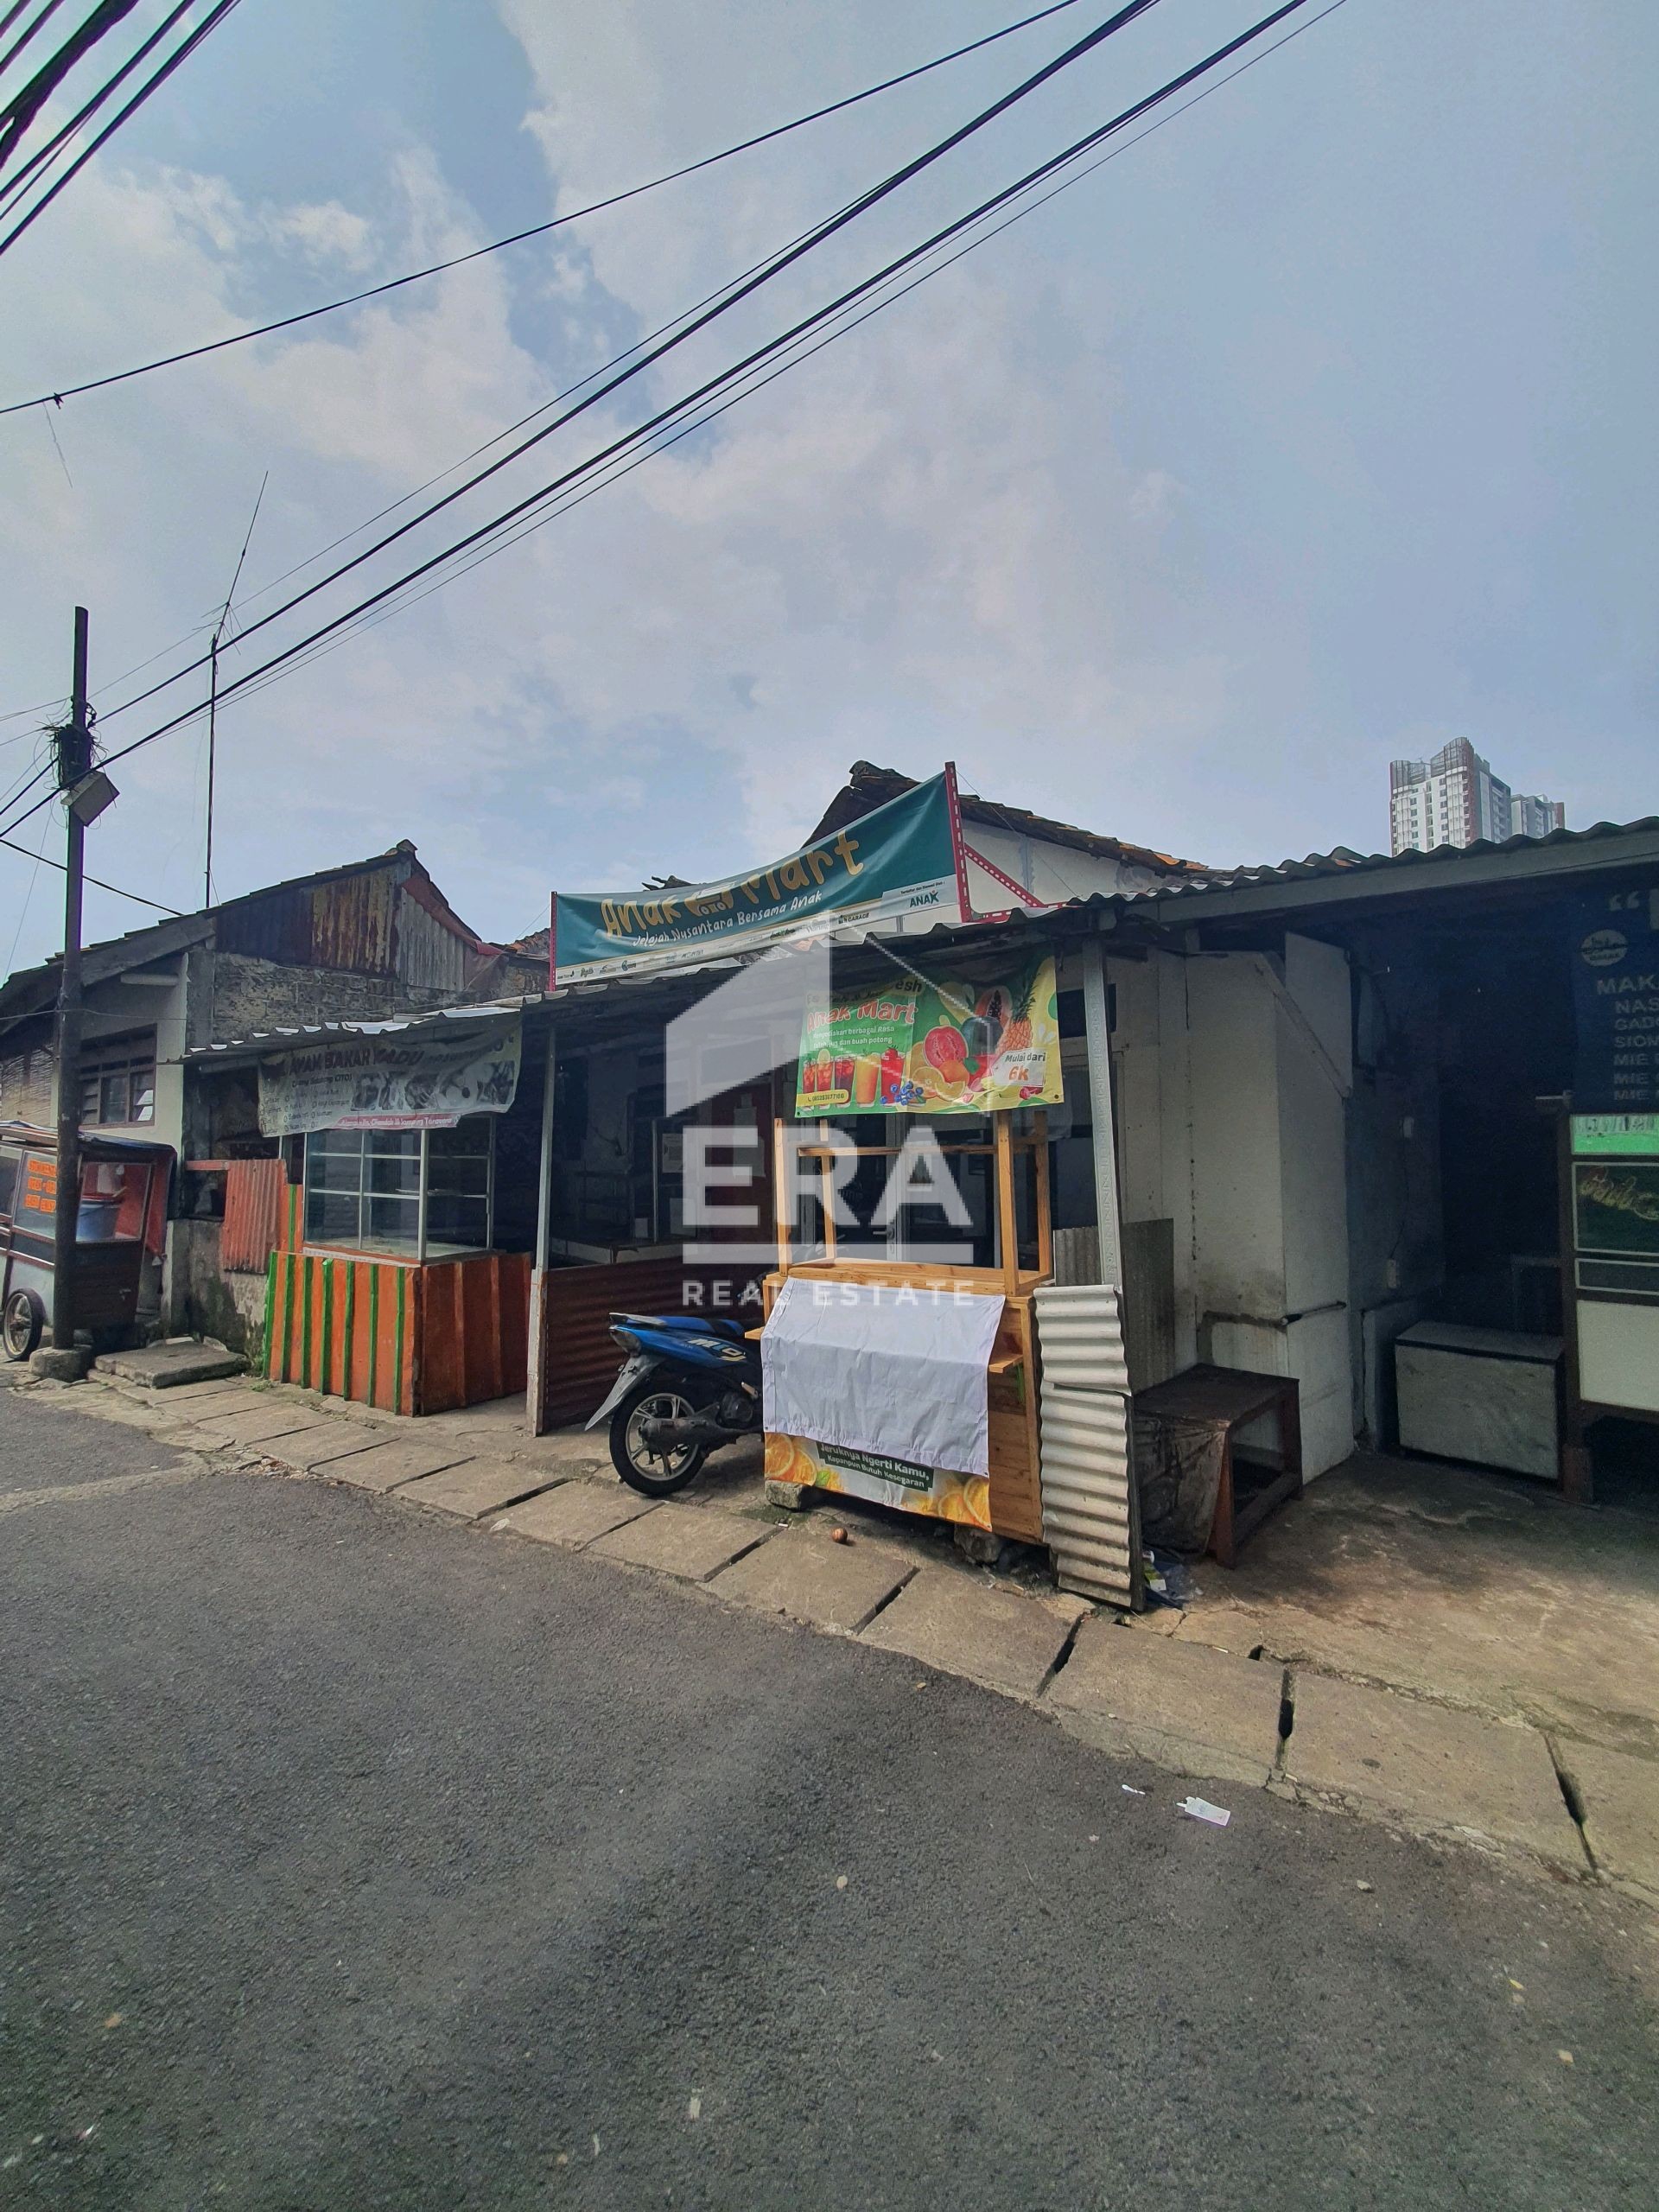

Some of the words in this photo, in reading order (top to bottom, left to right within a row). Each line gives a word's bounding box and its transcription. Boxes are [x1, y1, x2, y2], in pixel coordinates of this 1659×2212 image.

[601, 895, 681, 938] Anak
[741, 830, 864, 904] Mart
[910, 890, 939, 907] ANAK
[632, 930, 670, 947] Jelajah
[673, 918, 734, 941] Nusantara
[736, 905, 786, 925] Bersama
[791, 890, 823, 910] Anak
[807, 1006, 851, 1033] Anak
[857, 1000, 918, 1024] Mart
[868, 1036, 893, 1046] potong
[1005, 1052, 1025, 1063] Mulai
[1027, 1052, 1046, 1062] dari
[820, 1444, 861, 1461] Jeruknya
[861, 1453, 893, 1471] Ngerti
[894, 1460, 930, 1481] Kamu,
[827, 1455, 861, 1470] Kapanpun
[884, 1470, 925, 1488] Kesegaran
